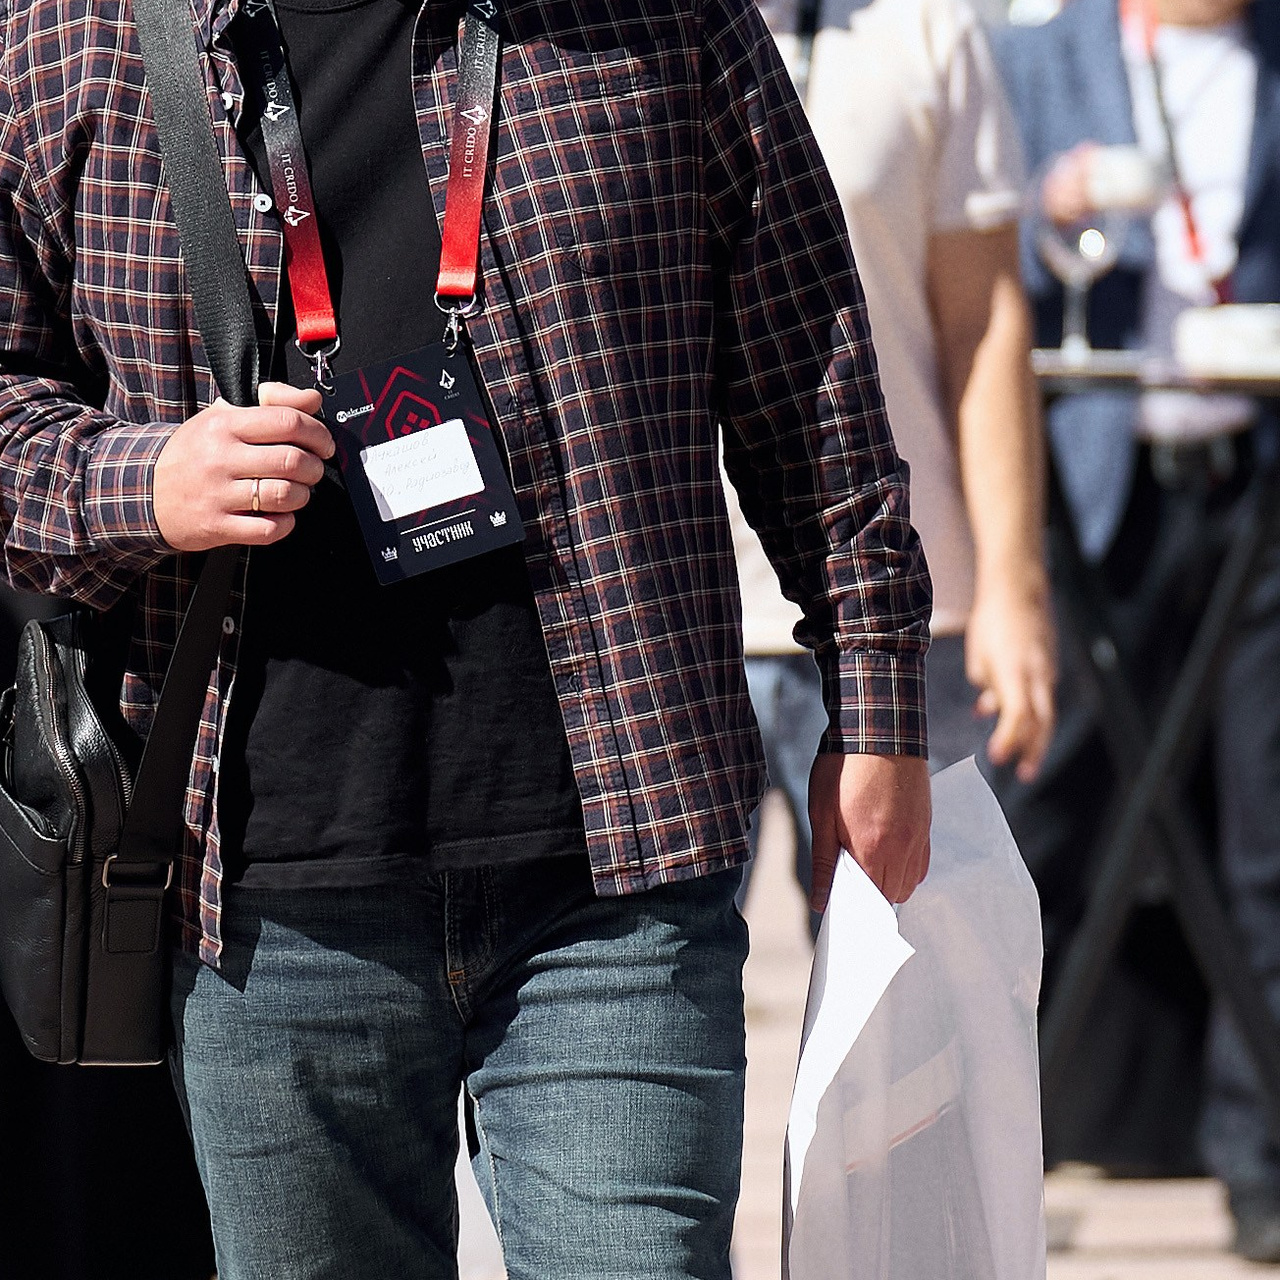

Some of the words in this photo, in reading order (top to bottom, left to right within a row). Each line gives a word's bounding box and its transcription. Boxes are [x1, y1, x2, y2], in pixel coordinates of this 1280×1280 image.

[474, 58, 484, 71] IT
[464, 127, 477, 166] CREDO
[281, 153, 292, 164] IT
[463, 167, 472, 179] IT
[283, 166, 299, 204] CREDO
